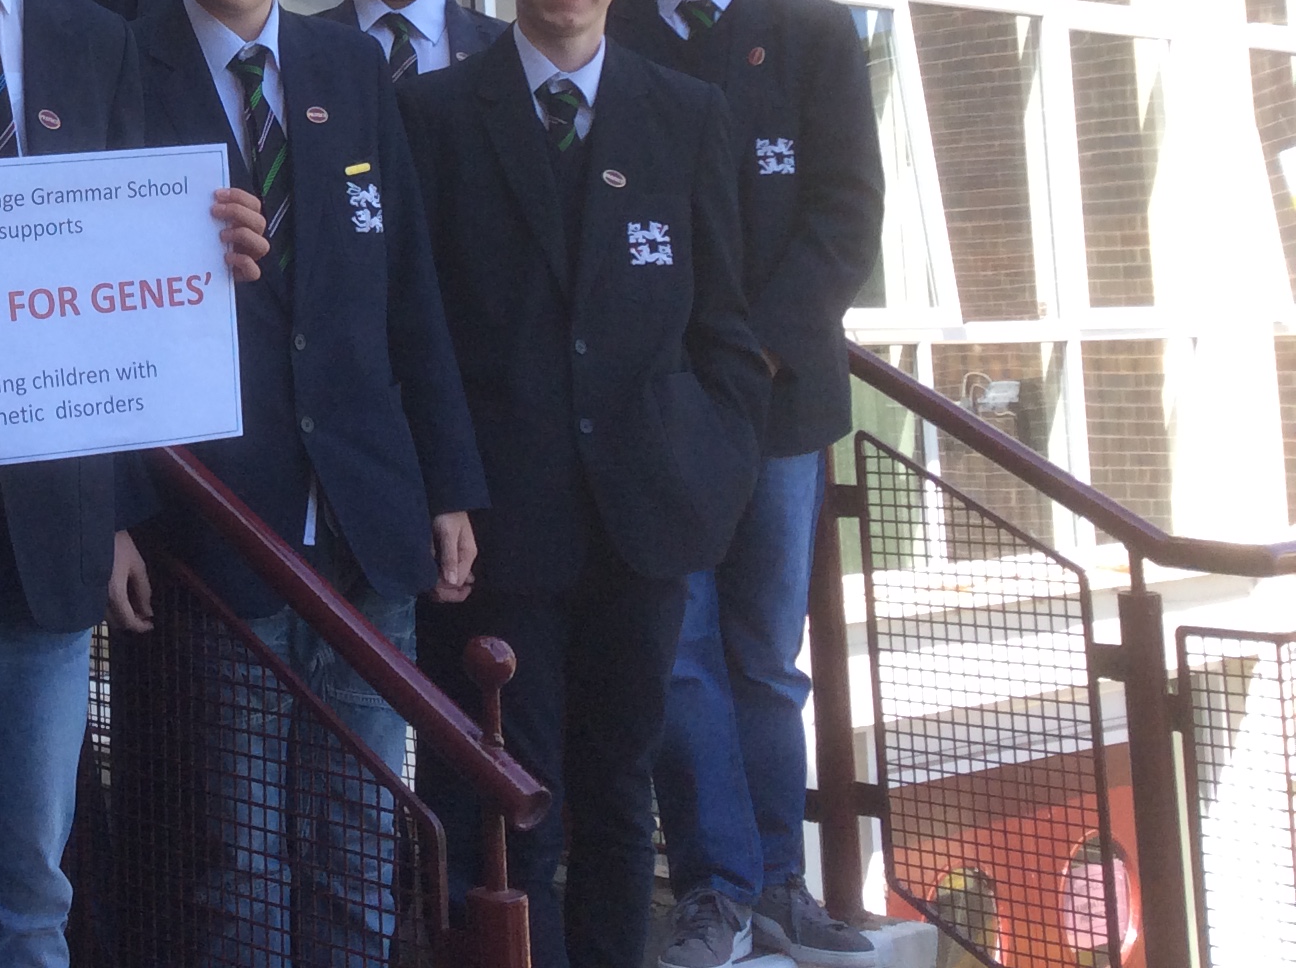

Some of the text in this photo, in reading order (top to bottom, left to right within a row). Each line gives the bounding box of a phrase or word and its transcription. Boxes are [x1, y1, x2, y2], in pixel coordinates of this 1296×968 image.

[31, 185, 122, 206] Grammar
[127, 175, 189, 199] School
[8, 286, 81, 322] FOR
[32, 366, 110, 390] children
[115, 360, 158, 381] with
[55, 395, 144, 420] disorders
